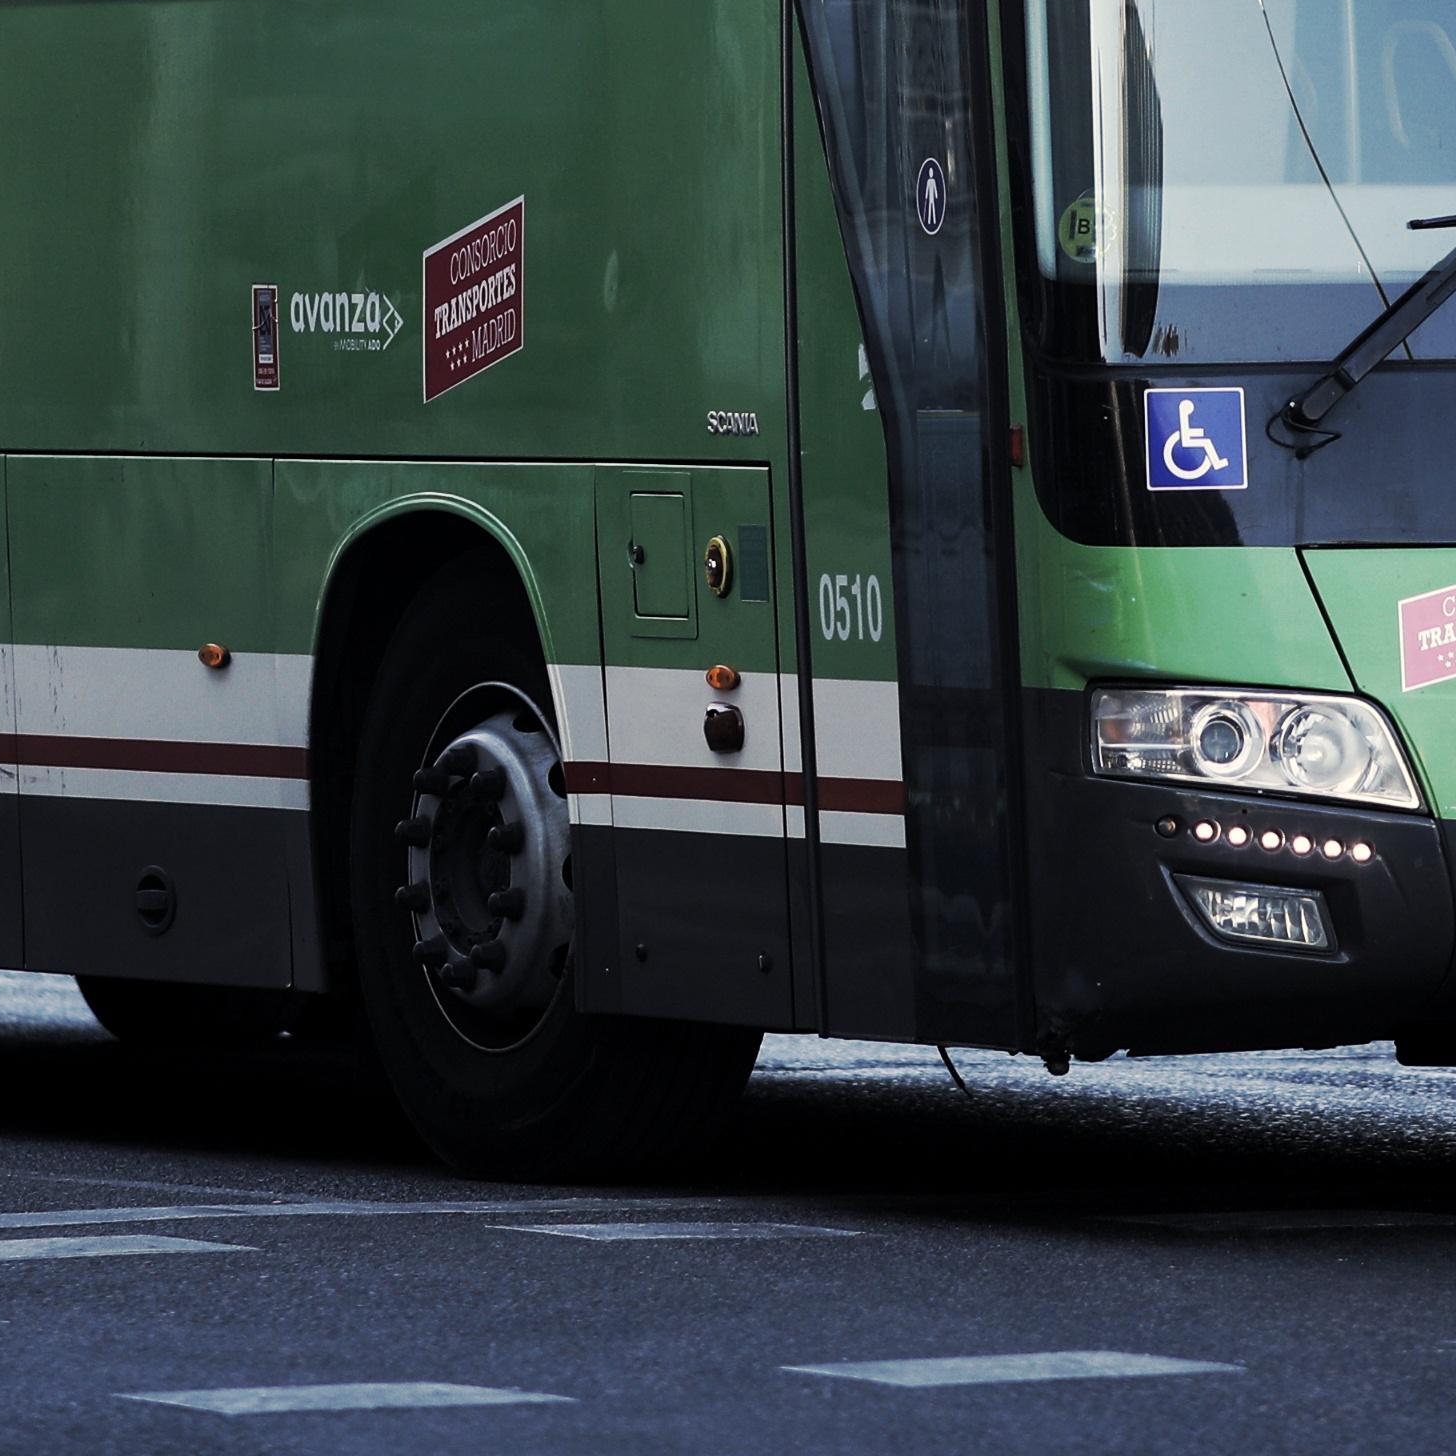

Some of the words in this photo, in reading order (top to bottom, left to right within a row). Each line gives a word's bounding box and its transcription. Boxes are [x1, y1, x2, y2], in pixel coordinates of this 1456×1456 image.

[1078, 219, 1090, 234] B
[450, 218, 517, 286] CONSORCIO
[290, 292, 381, 333] avanza
[433, 262, 517, 340] TRANSPORTES
[368, 339, 381, 351] ADO
[471, 307, 517, 363] MADRID
[707, 410, 760, 436] SCANIA
[819, 573, 882, 642] 0510
